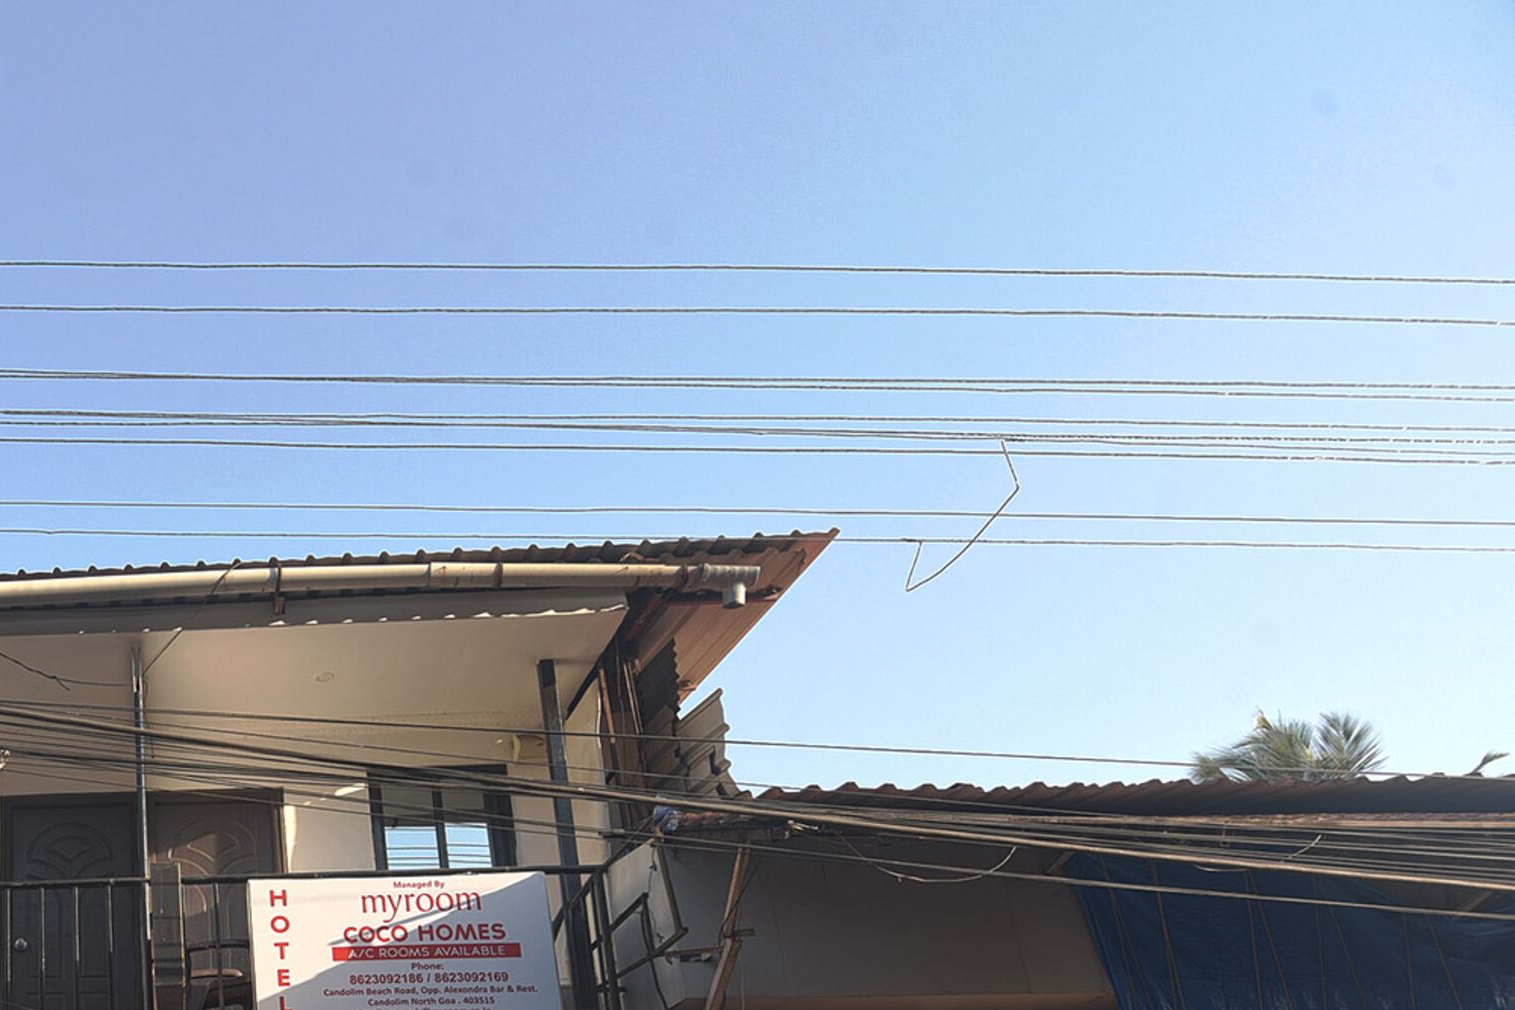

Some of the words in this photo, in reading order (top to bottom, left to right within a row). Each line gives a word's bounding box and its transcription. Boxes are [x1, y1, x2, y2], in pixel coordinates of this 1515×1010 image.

[393, 880, 433, 889] Managed
[435, 880, 445, 889] By
[361, 890, 482, 922] myroom
[343, 924, 408, 944] COCO
[418, 922, 506, 942] HOMES
[348, 948, 375, 959] A/C
[379, 946, 430, 959] ROOMS
[435, 945, 505, 957] AVAILABLE
[411, 962, 444, 971] Phone:
[350, 974, 424, 985] 8623092186
[434, 972, 509, 983] 8623092169
[323, 987, 364, 996] Candolim
[366, 987, 392, 995] Beach
[489, 985, 505, 993] Bar
[507, 985, 514, 993] &
[516, 985, 539, 993] Rest.
[368, 998, 409, 1006] Candolim
[438, 997, 456, 1005] Goa
